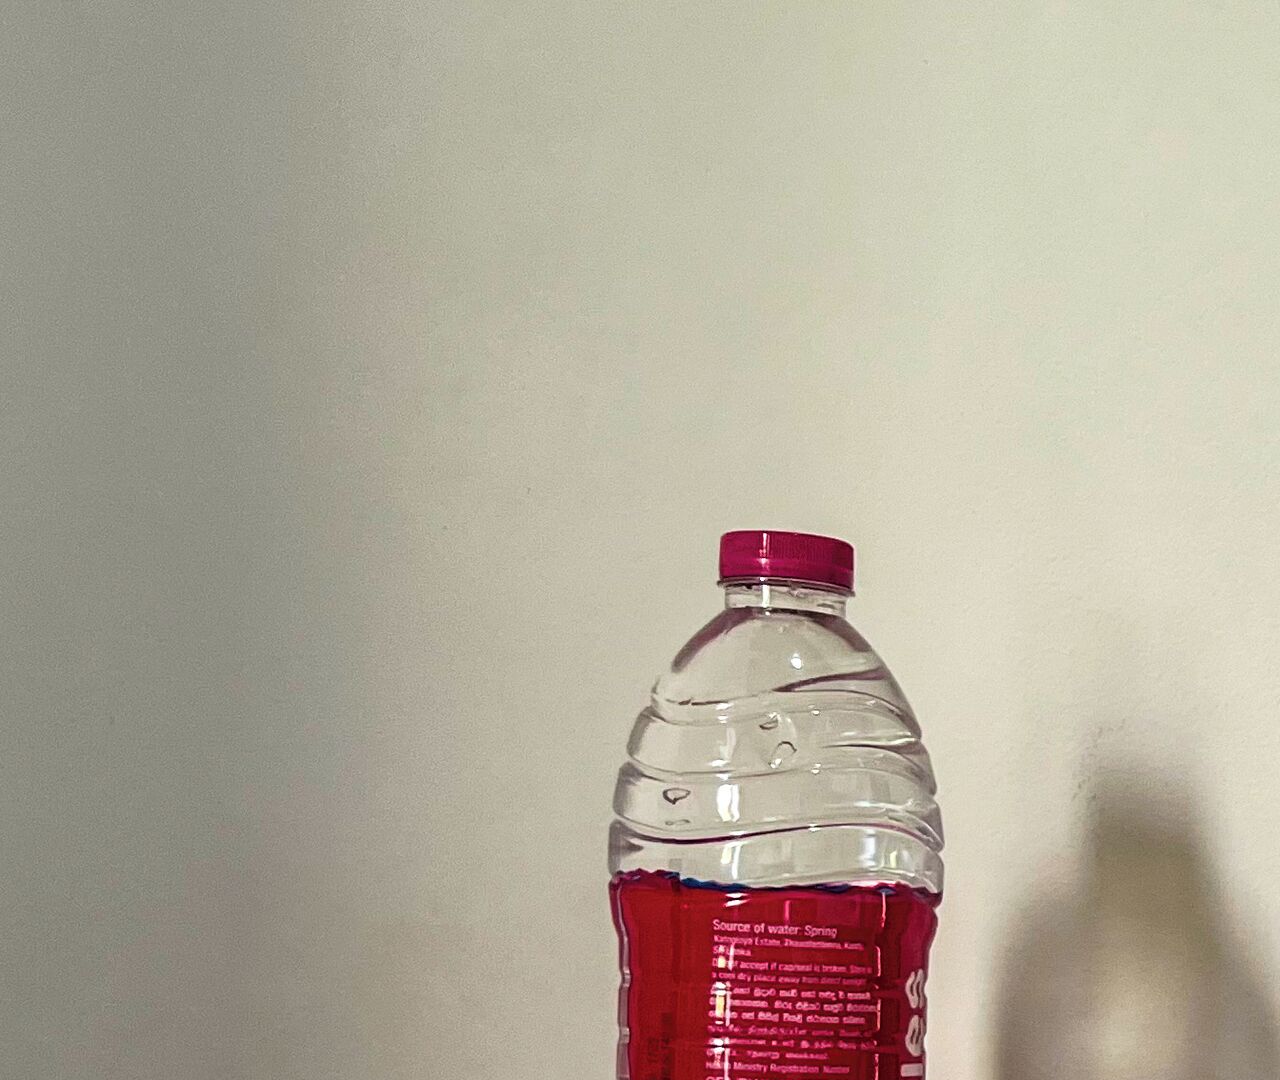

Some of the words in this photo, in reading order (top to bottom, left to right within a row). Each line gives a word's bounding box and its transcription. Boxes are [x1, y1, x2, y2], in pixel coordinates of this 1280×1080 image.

[712, 919, 751, 932] Source
[753, 923, 765, 934] of
[804, 925, 837, 939] Spring
